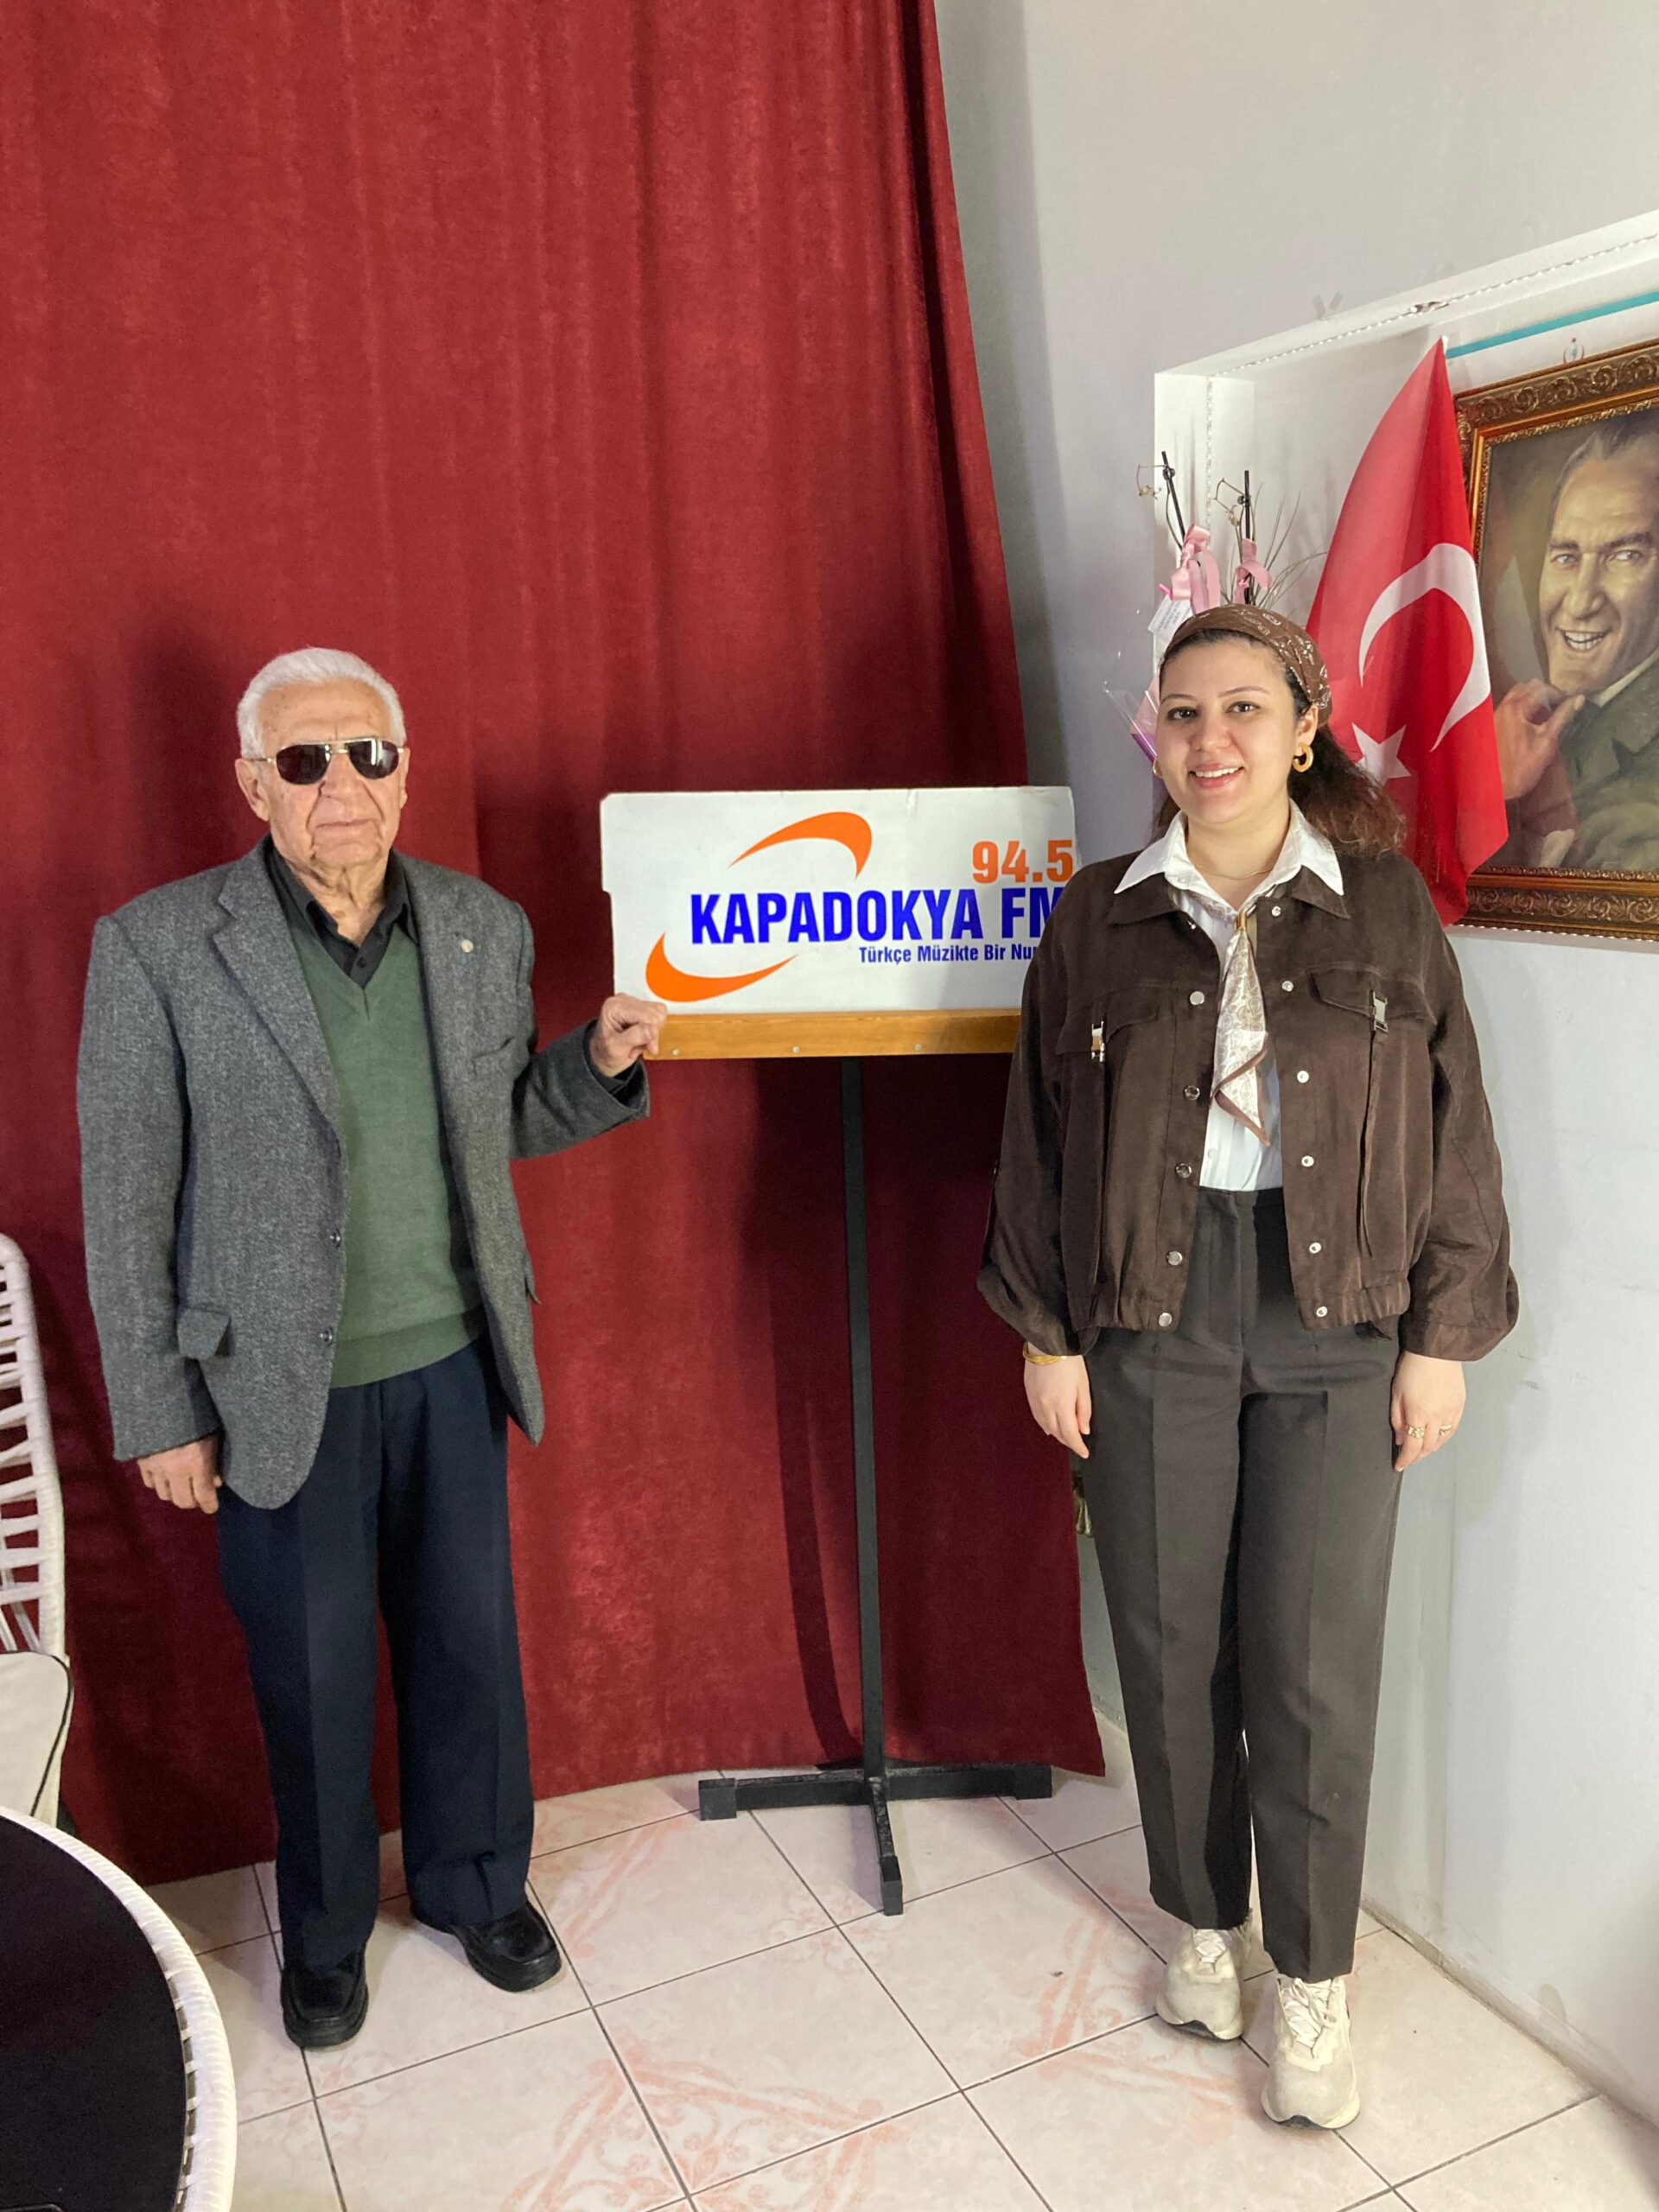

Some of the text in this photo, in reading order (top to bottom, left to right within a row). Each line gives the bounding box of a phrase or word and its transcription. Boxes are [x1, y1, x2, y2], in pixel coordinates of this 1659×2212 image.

[972, 839, 1073, 884] 94.5
[690, 887, 1065, 944] KAPADOKYA FM
[859, 944, 1038, 964] Türkçe Müzikte Bir Nu
